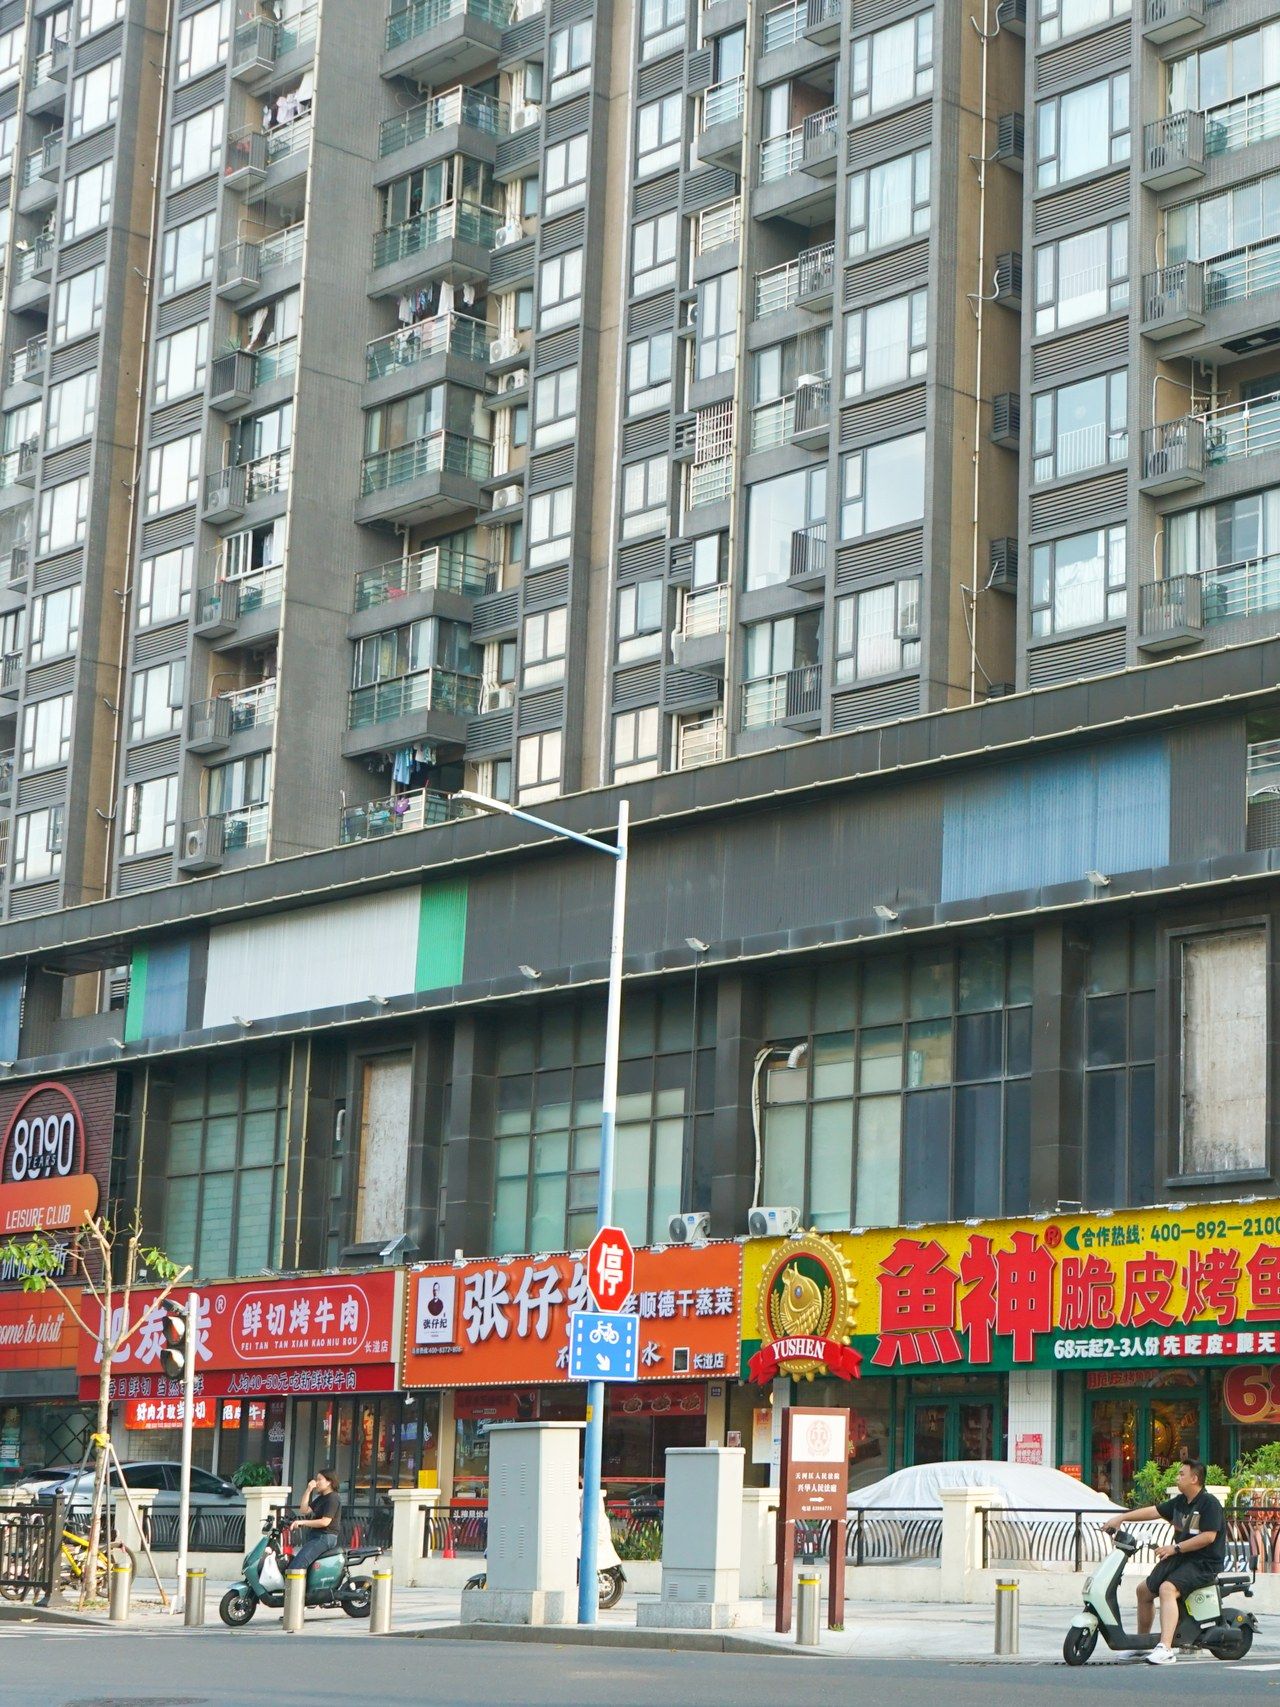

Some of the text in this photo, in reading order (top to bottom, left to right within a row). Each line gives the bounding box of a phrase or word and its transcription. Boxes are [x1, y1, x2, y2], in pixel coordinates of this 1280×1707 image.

[11, 1112, 75, 1181] 8090
[28, 1154, 57, 1169] YEARS
[5, 1204, 71, 1230] LEISURE CLUB
[597, 1243, 624, 1296] 停
[241, 1294, 360, 1338] 鲜切烤牛肉
[423, 1318, 448, 1329] 张仔纪
[24, 1313, 37, 1344] to
[36, 1312, 65, 1343] visit
[241, 1337, 358, 1351] FEI TAN TAN XIAN KAO NIU ROU
[771, 1337, 827, 1360] YUSHEN
[156, 1373, 205, 1397] 当然鲜
[227, 1368, 357, 1393] 人均40-50元吃新鲜烤牛肉
[136, 1400, 206, 1422] 好肉才敢当切
[795, 1472, 840, 1480] 天河区人民法院
[797, 1483, 837, 1493] 兴华人民法庭
